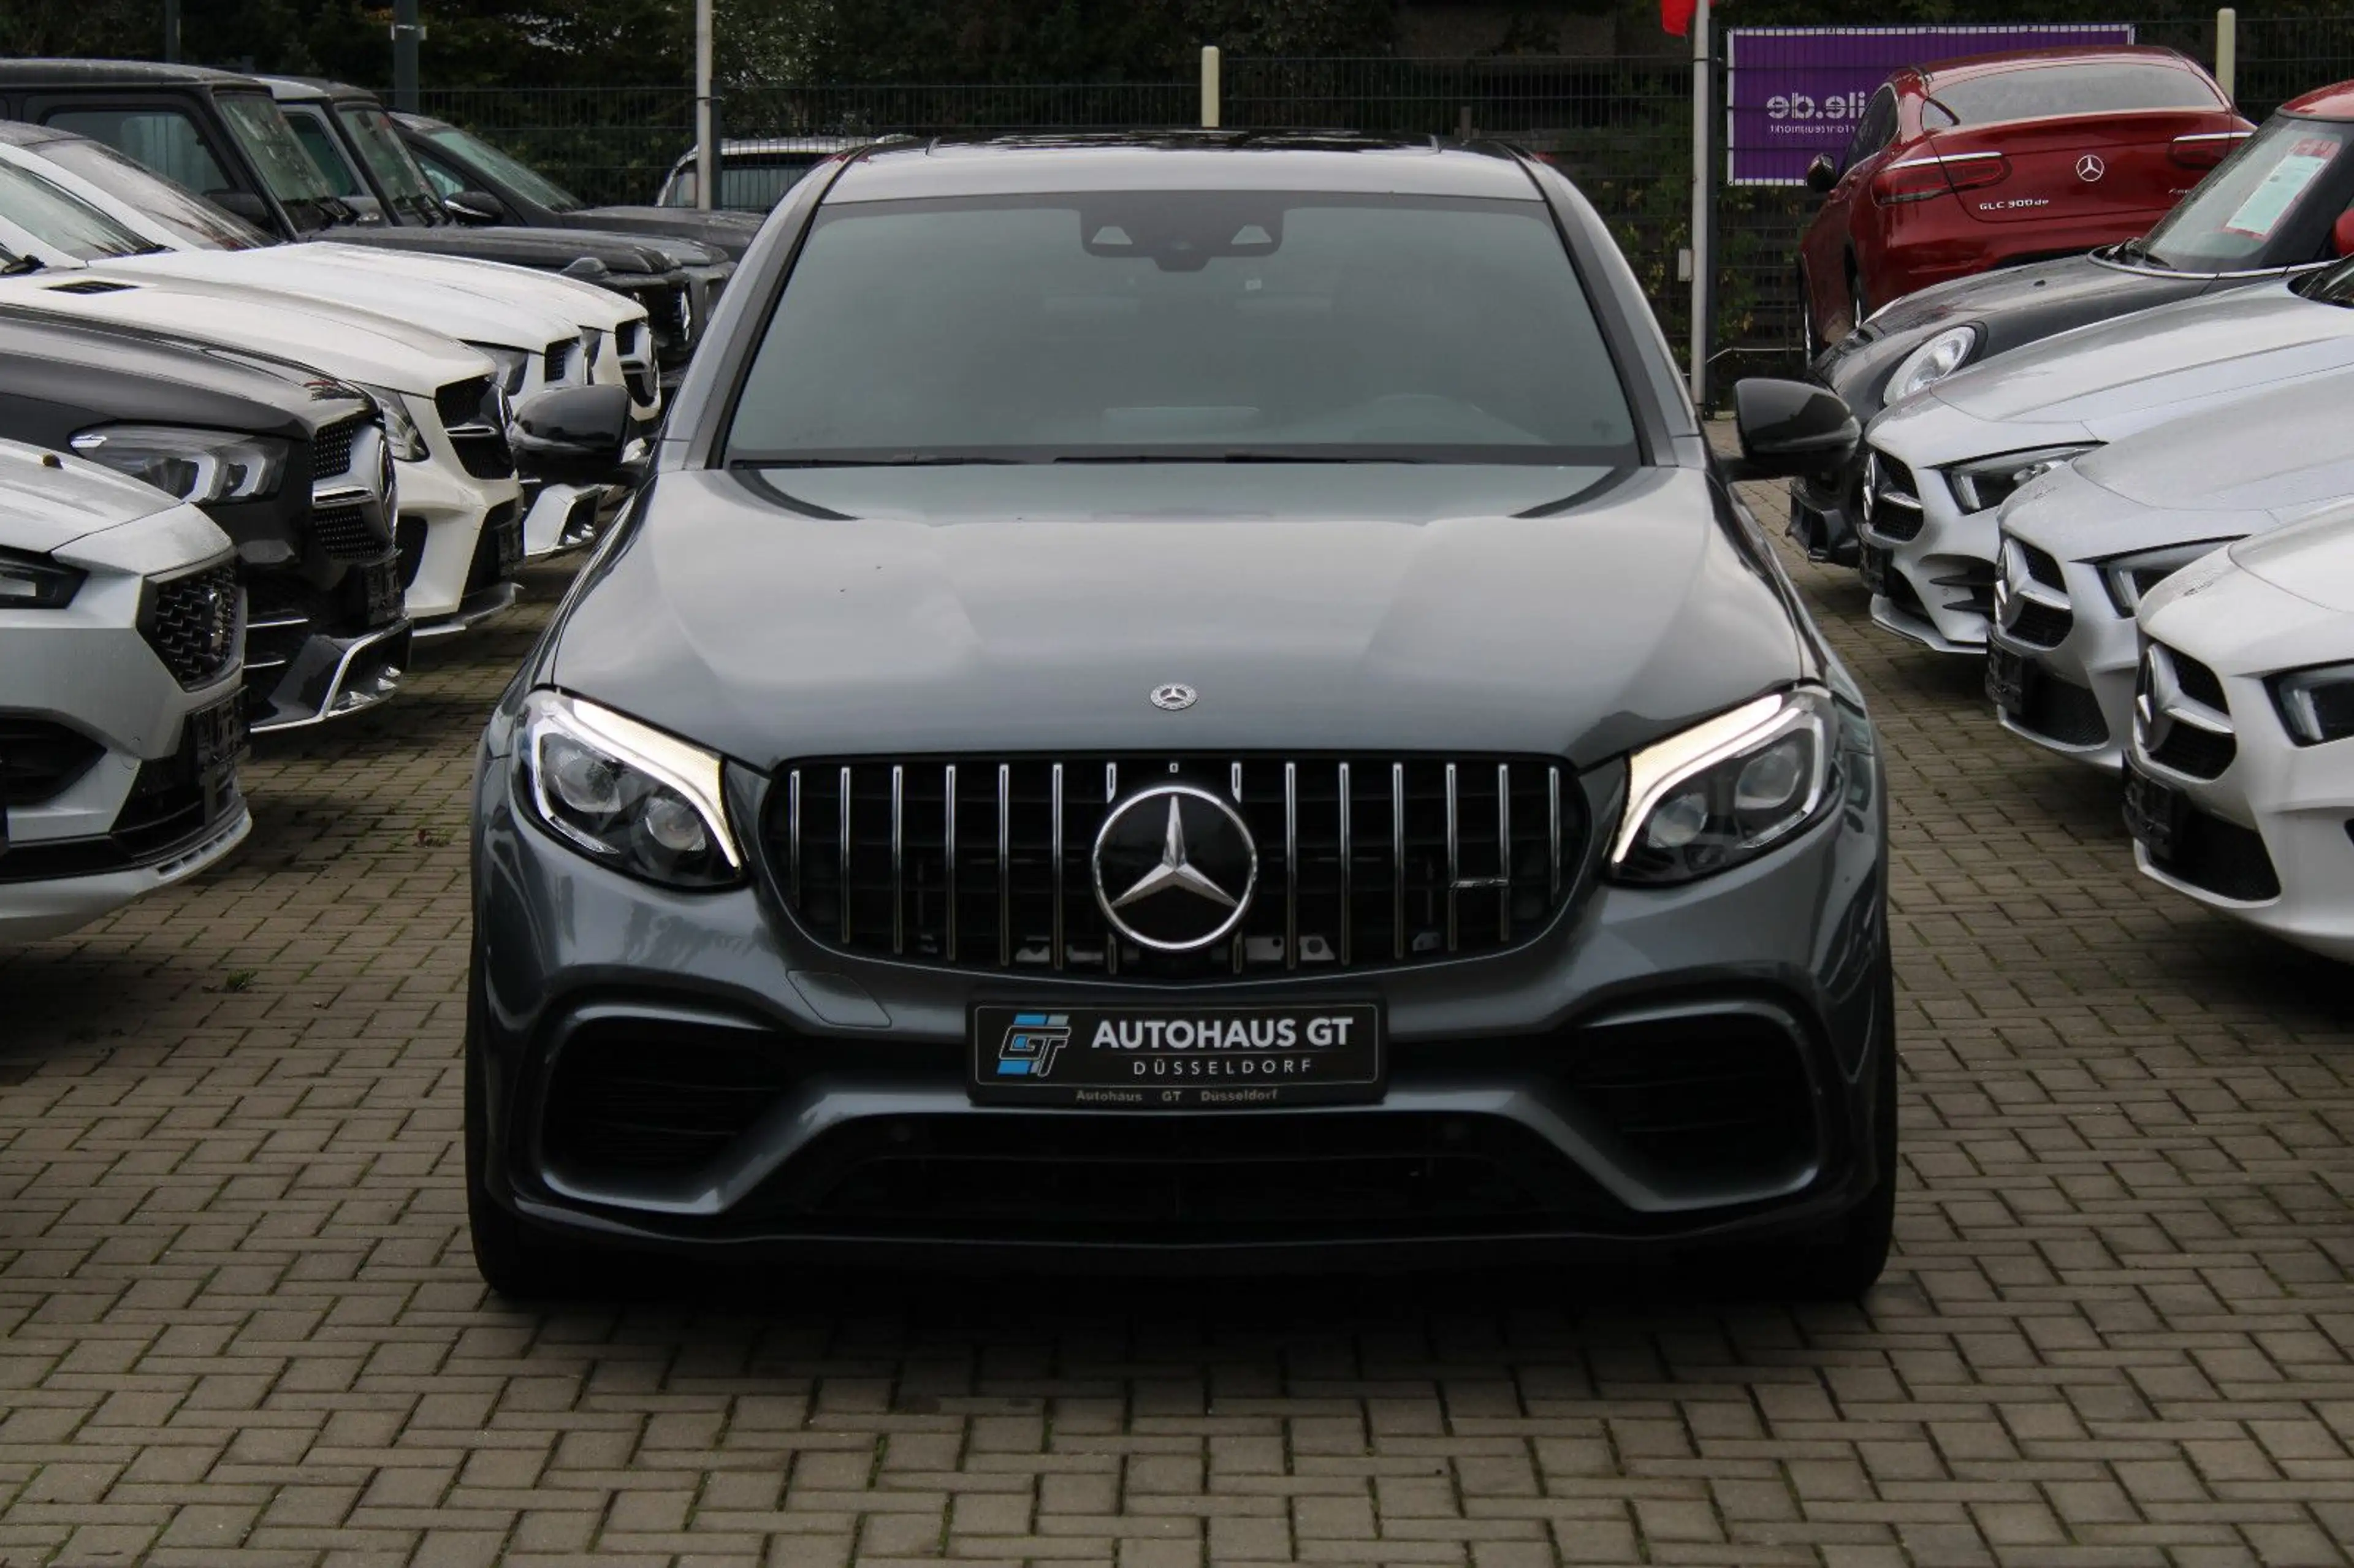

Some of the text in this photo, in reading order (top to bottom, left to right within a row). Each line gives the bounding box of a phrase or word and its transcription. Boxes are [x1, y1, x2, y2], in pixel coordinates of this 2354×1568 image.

[1979, 201, 2005, 210] GLC
[1091, 1016, 1354, 1049] AUTOHAUS GT
[1133, 1058, 1311, 1076] DÜSSELDORF
[1075, 1089, 1143, 1102] Autohaus
[1162, 1090, 1182, 1102] GT
